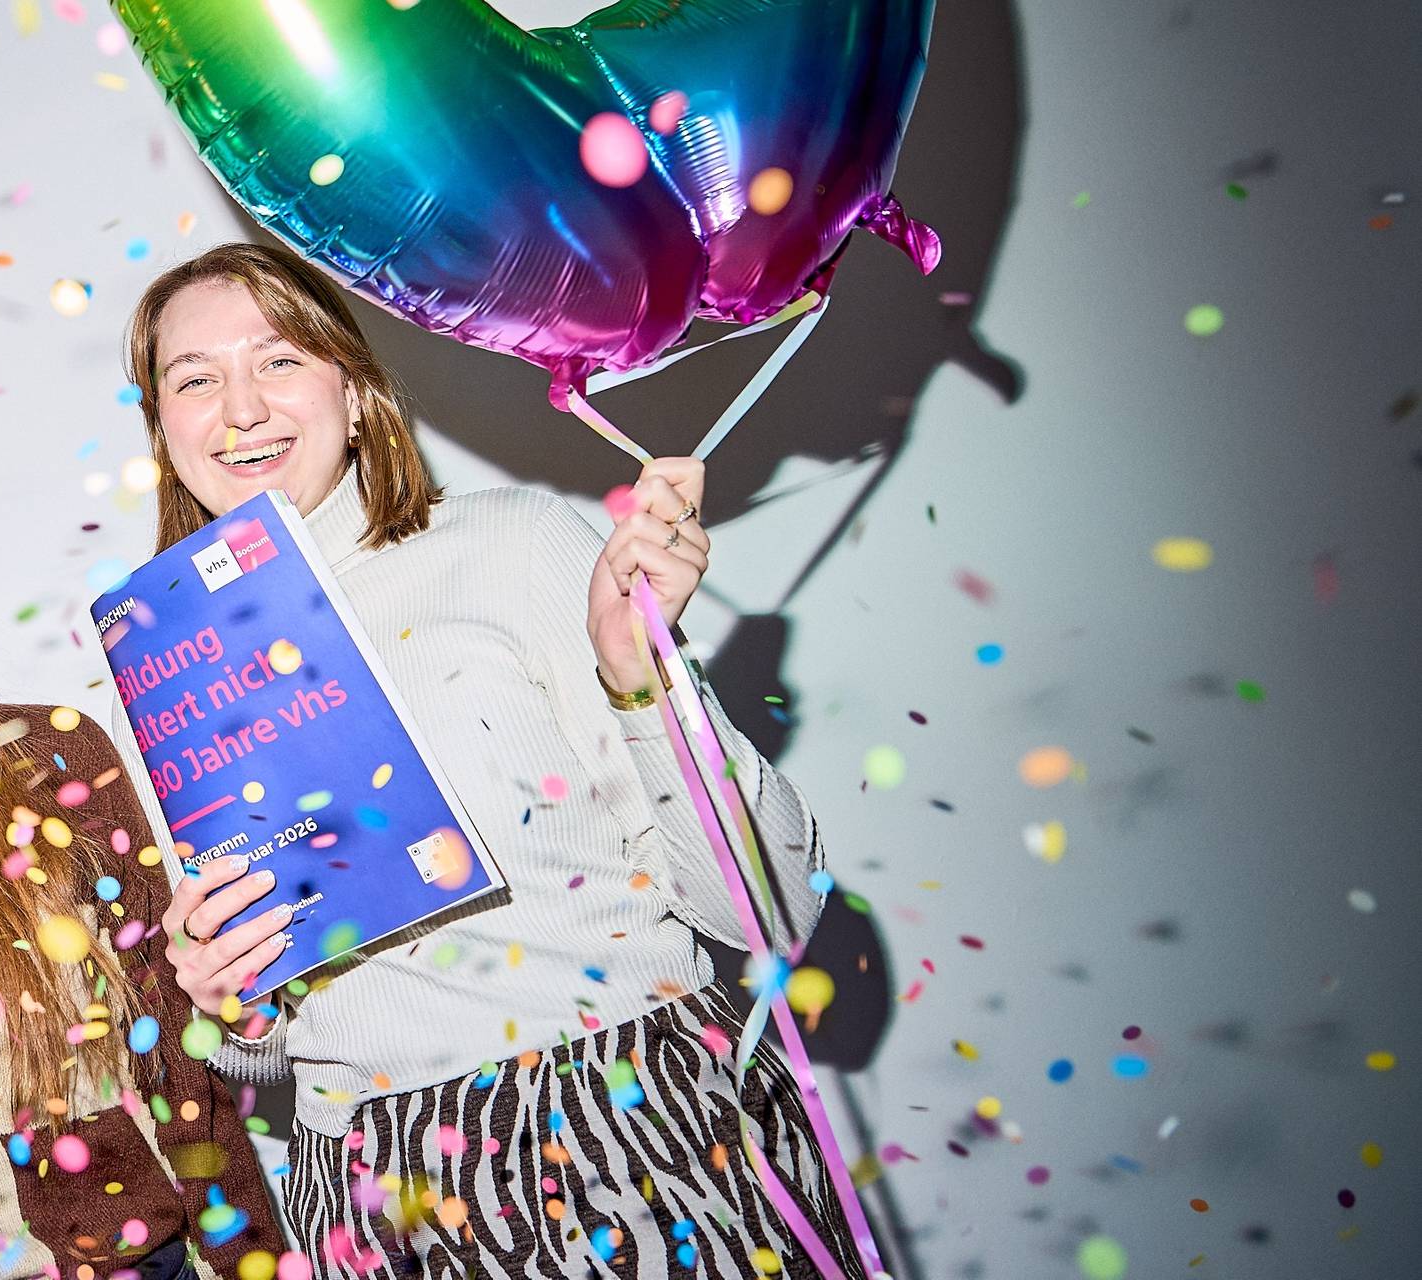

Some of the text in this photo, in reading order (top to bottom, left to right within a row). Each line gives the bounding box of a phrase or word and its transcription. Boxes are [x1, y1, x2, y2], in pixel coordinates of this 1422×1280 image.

[205, 534, 270, 575] vhs Bochum
[99, 597, 137, 634] BOCHUM
[115, 625, 225, 708] Bildung
[133, 647, 304, 754] altert nich
[148, 678, 348, 800] 80 Jahre vhs
[274, 817, 318, 849] 2026
[290, 892, 324, 913] ochum
